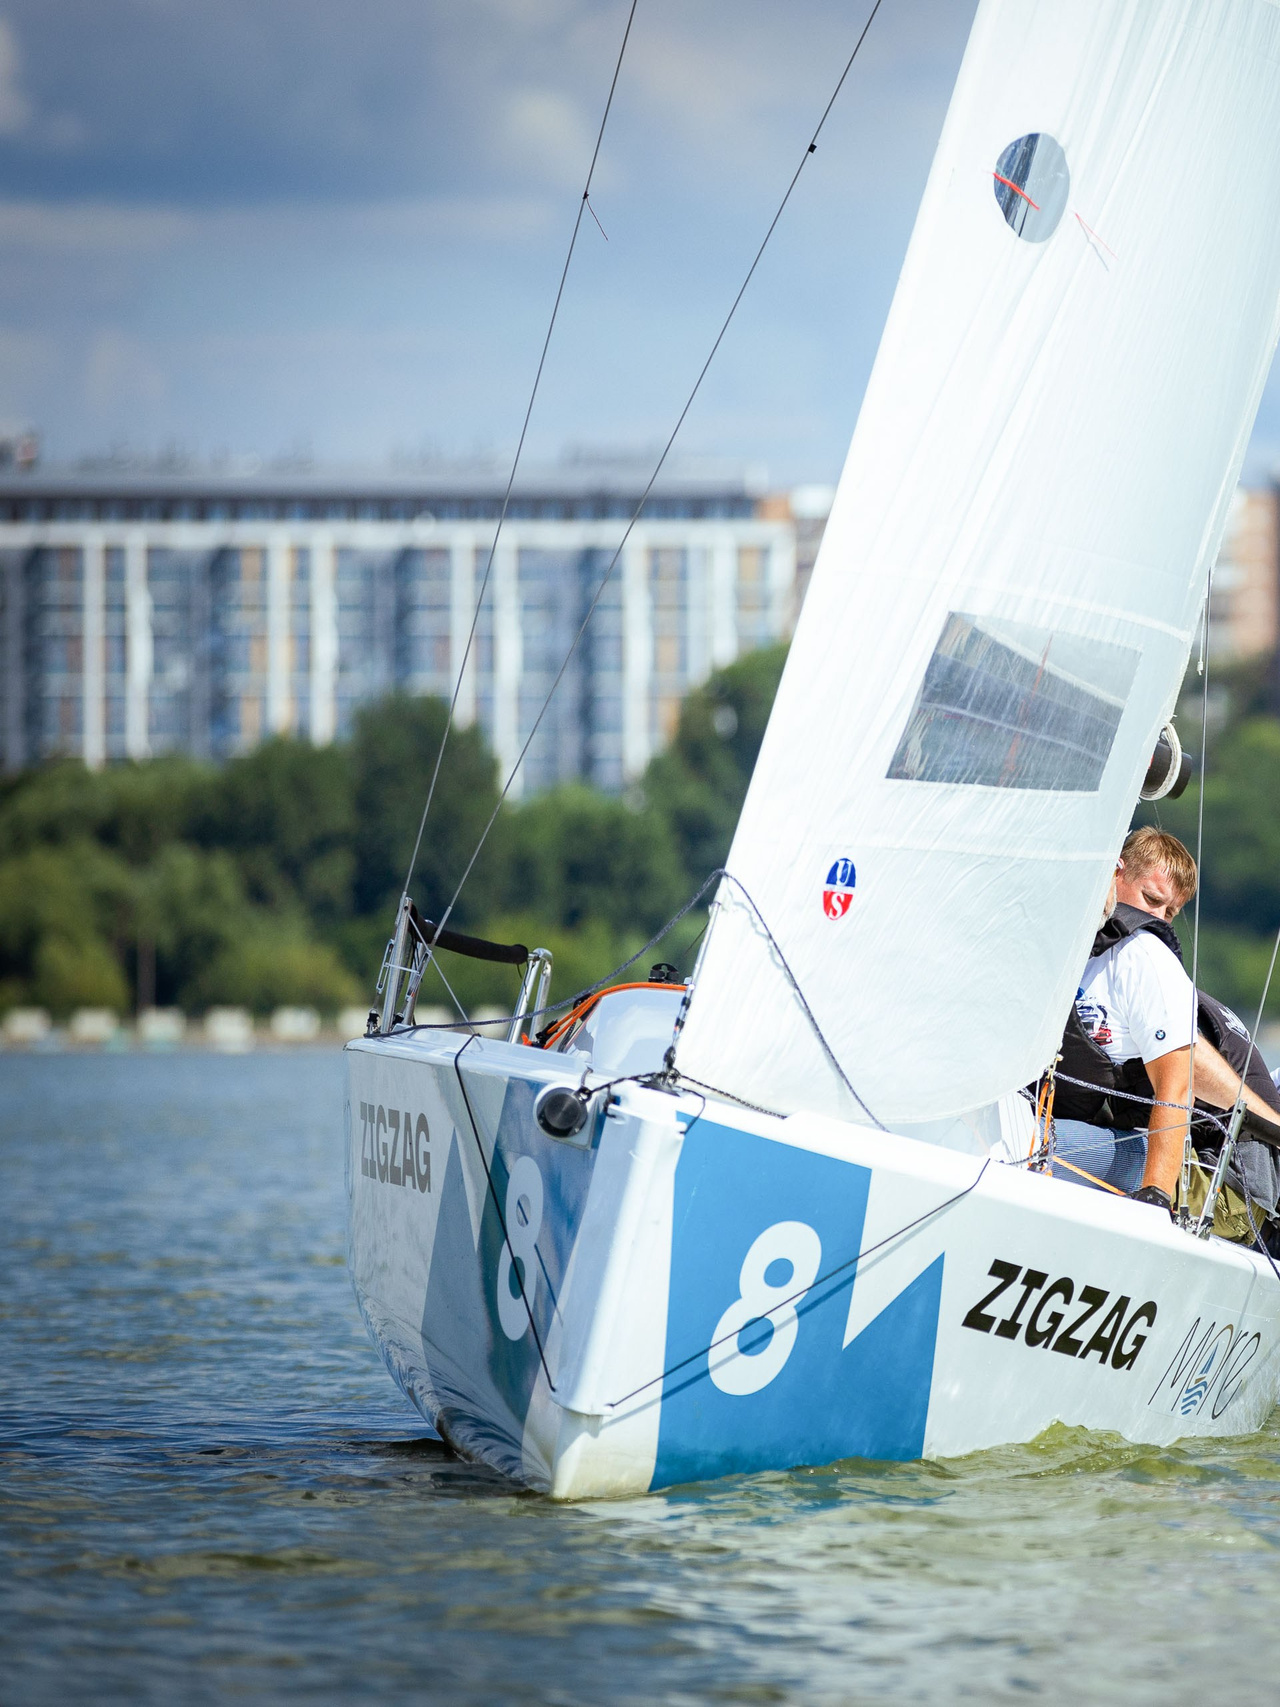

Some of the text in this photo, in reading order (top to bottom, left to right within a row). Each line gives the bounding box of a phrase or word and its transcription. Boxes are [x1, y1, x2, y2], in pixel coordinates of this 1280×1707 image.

[360, 1101, 431, 1194] ZIGZAG
[497, 1156, 543, 1341] 8
[708, 1220, 822, 1396] 8
[961, 1258, 1158, 1371] ZIGZAG
